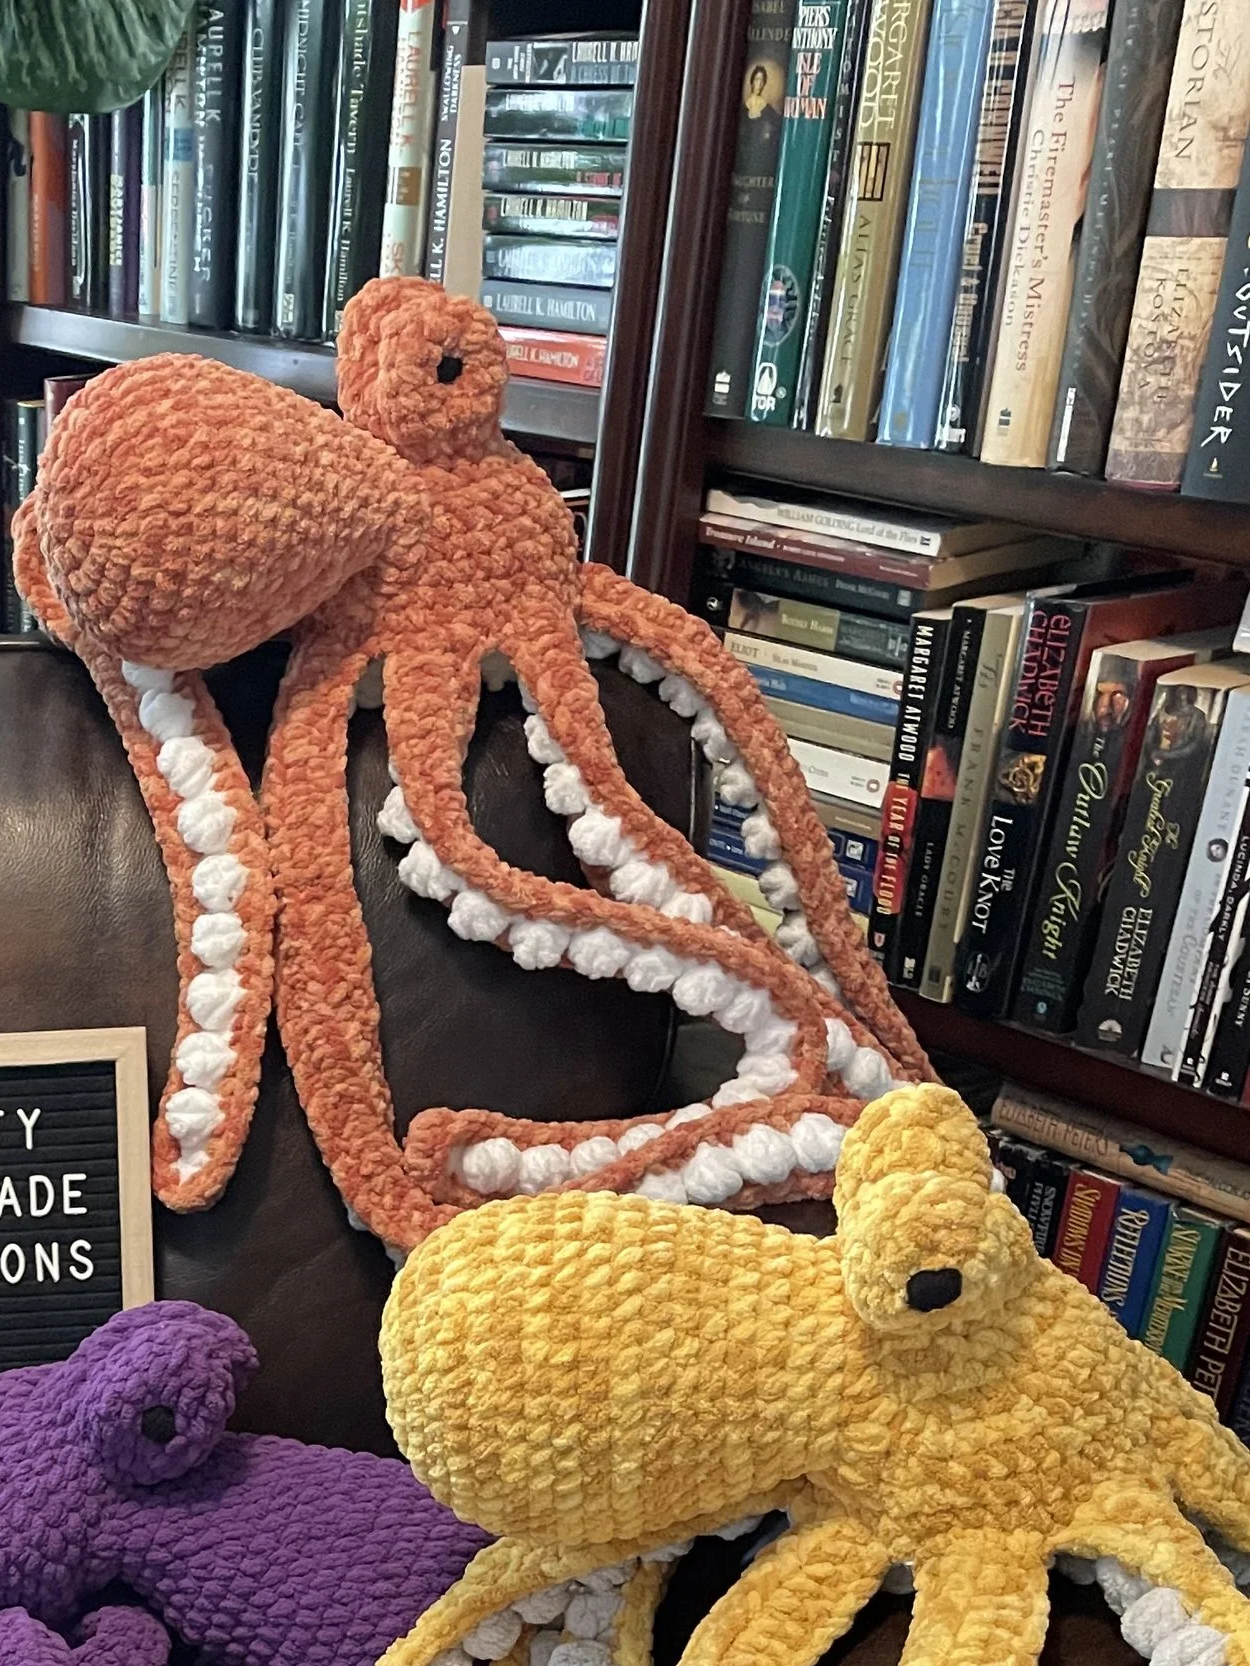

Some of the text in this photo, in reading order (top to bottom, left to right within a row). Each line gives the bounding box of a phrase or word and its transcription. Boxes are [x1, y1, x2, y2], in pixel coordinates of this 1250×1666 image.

[791, 27, 838, 49] ANTHONY
[798, 5, 831, 27] PIERS
[795, 52, 822, 74] ISLE
[1174, 1, 1219, 160] STORIAN
[347, 83, 364, 155] Tavern
[783, 97, 828, 119] WOMAN
[976, 79, 1015, 195] CORNWELL
[342, 168, 356, 217] Laurell
[433, 138, 452, 232] HAMILTON
[431, 238, 445, 254] K.
[851, 215, 871, 284] ALIAS
[1005, 129, 1045, 327] Christie Dickason
[1015, 78, 1076, 372] The Firemaster's Mistress
[337, 239, 351, 301] Hamilton
[545, 298, 596, 321] HAMILTON
[1138, 278, 1167, 389] KOSTOVA
[1154, 267, 1190, 400] ELIZABETH
[1199, 282, 1250, 448] OUTSIDER
[752, 395, 776, 411] TOR
[705, 526, 776, 550] Treasure Island
[777, 507, 814, 523] WILLIAM
[815, 514, 855, 532] GOLDING
[856, 522, 876, 536] Lord
[898, 531, 918, 545] Flies
[907, 625, 935, 700] MARGARET
[947, 630, 972, 729] MARGARET ATWOOD
[1009, 609, 1048, 734] CHADWICK
[898, 705, 922, 762] ATWOOD
[957, 728, 985, 810] FRANK
[885, 834, 901, 850] OF
[889, 797, 910, 835] YEAR
[1065, 762, 1108, 859] Outlaw
[1128, 771, 1174, 898] Greatest Knight
[876, 874, 897, 915] FLOOD
[884, 851, 899, 870] THE
[914, 842, 934, 918] LADY ORACLE
[971, 872, 1002, 934] KNOT
[1042, 862, 1082, 960] Knight
[1217, 895, 1237, 940] DARKLY
[1104, 906, 1137, 998] CHADWICK
[1118, 907, 1154, 1001] ELIZABETH
[999, 1098, 1110, 1157] ELIZABETH PETERS
[1062, 1182, 1102, 1253] SHADOWS
[1100, 1207, 1151, 1309] REFLECTIONS
[1203, 1246, 1250, 1355] ELIZABETH
[1193, 1355, 1227, 1401] PET
